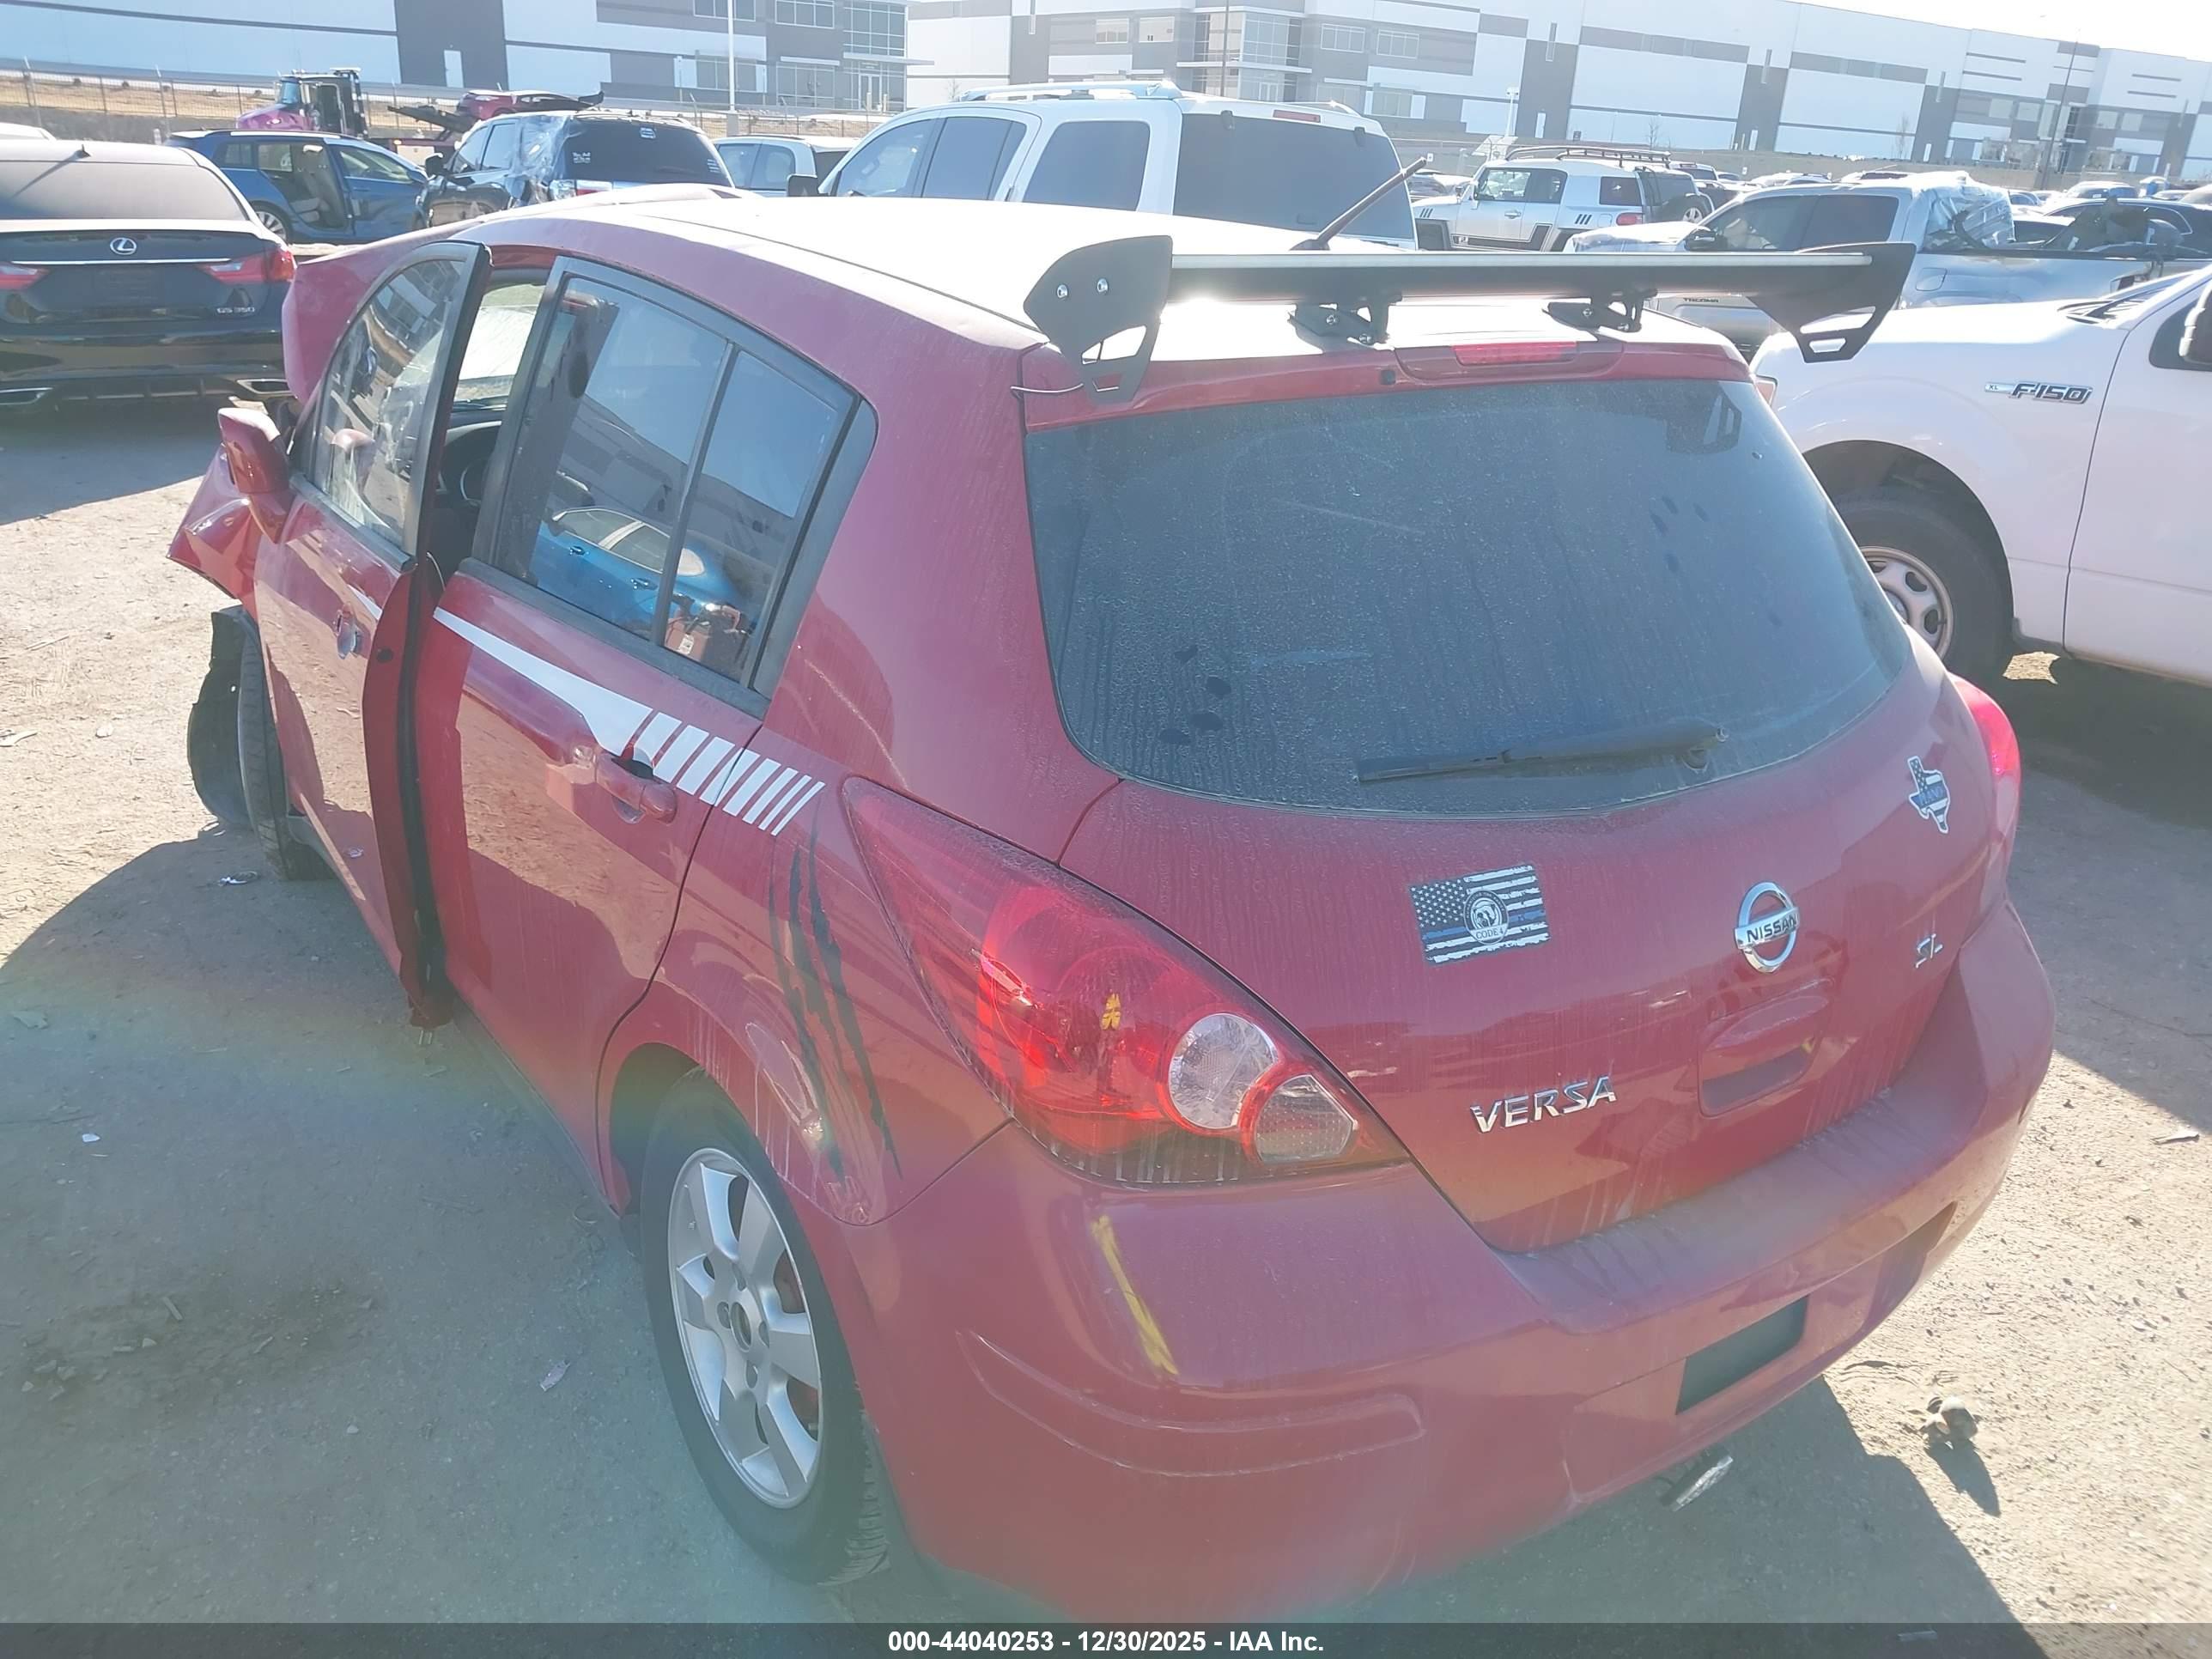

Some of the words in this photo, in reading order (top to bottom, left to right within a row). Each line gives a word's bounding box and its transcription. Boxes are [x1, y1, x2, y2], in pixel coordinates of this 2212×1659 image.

[1475, 928, 1498, 939] CODE
[1747, 913, 1798, 943] NISSAN
[1915, 933, 1943, 968] SL
[1470, 1075, 1617, 1133] VERSA
